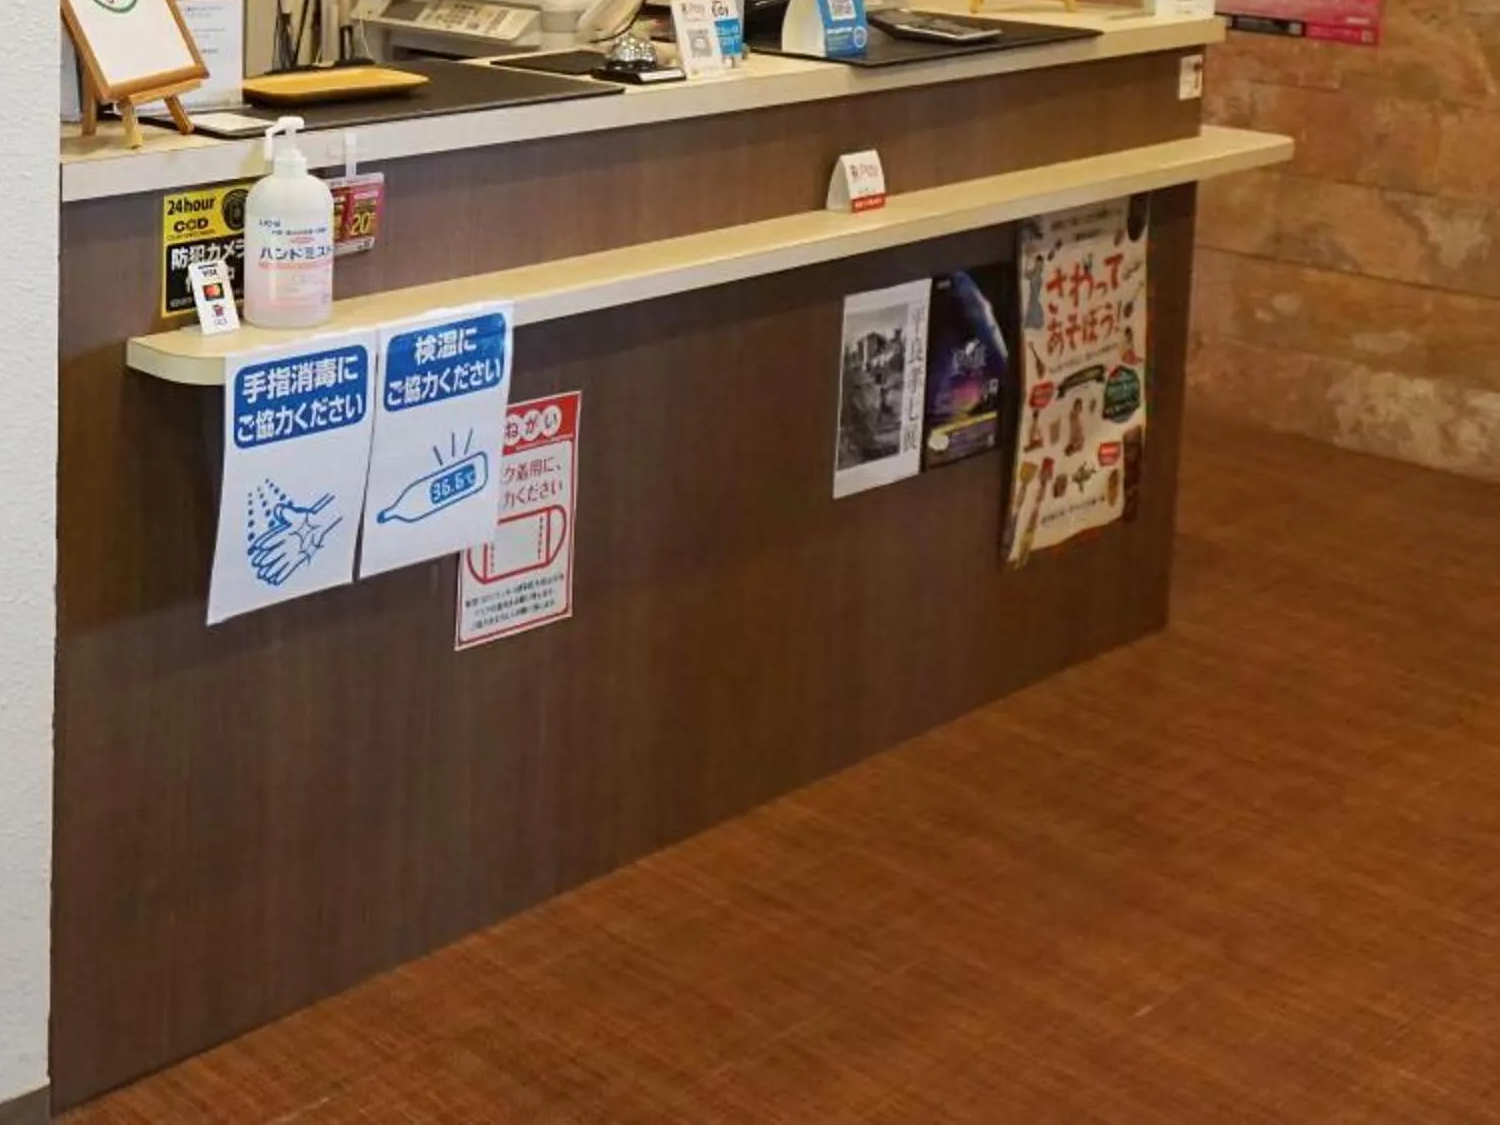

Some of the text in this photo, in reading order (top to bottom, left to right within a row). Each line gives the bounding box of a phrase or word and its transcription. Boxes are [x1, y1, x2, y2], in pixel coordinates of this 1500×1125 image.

[167, 195, 216, 216] 24hour
[1046, 253, 1124, 314] さわって
[414, 327, 478, 366] 検温に
[243, 354, 358, 404] 手指消毒に
[387, 359, 500, 406] ご協力ください
[238, 394, 362, 443] ご協力ください
